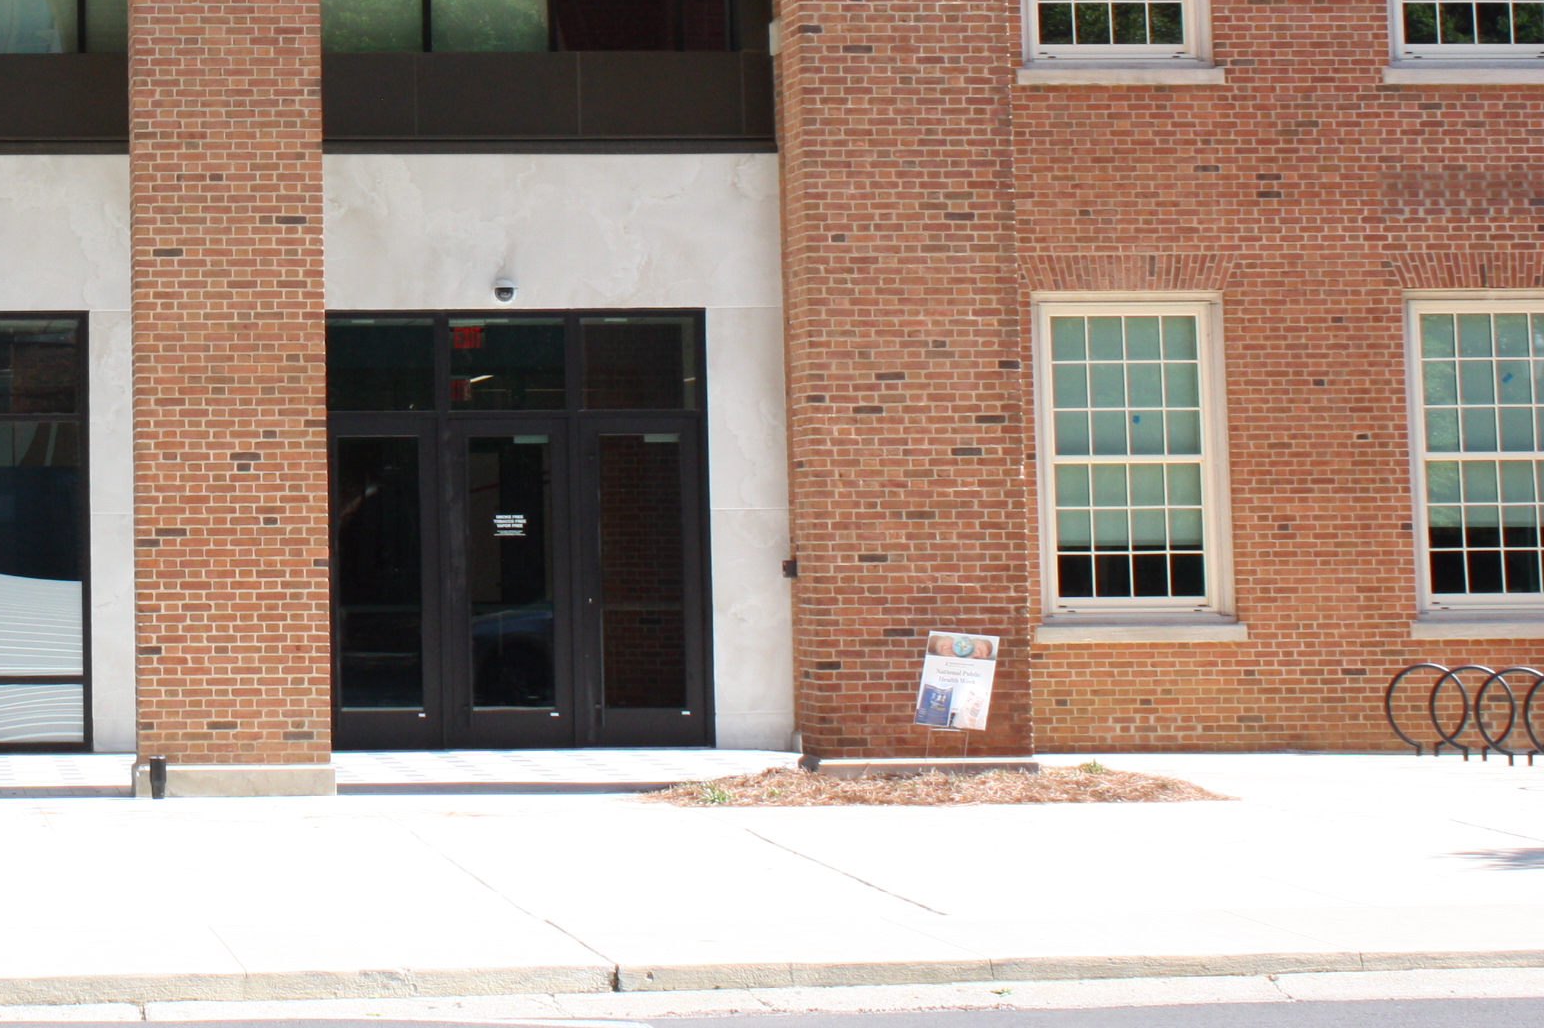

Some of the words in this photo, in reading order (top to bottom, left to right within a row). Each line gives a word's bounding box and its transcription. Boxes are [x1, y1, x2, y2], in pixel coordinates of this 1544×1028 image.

[454, 326, 481, 348] EXIT
[936, 668, 962, 676] National
[962, 670, 982, 678] Public
